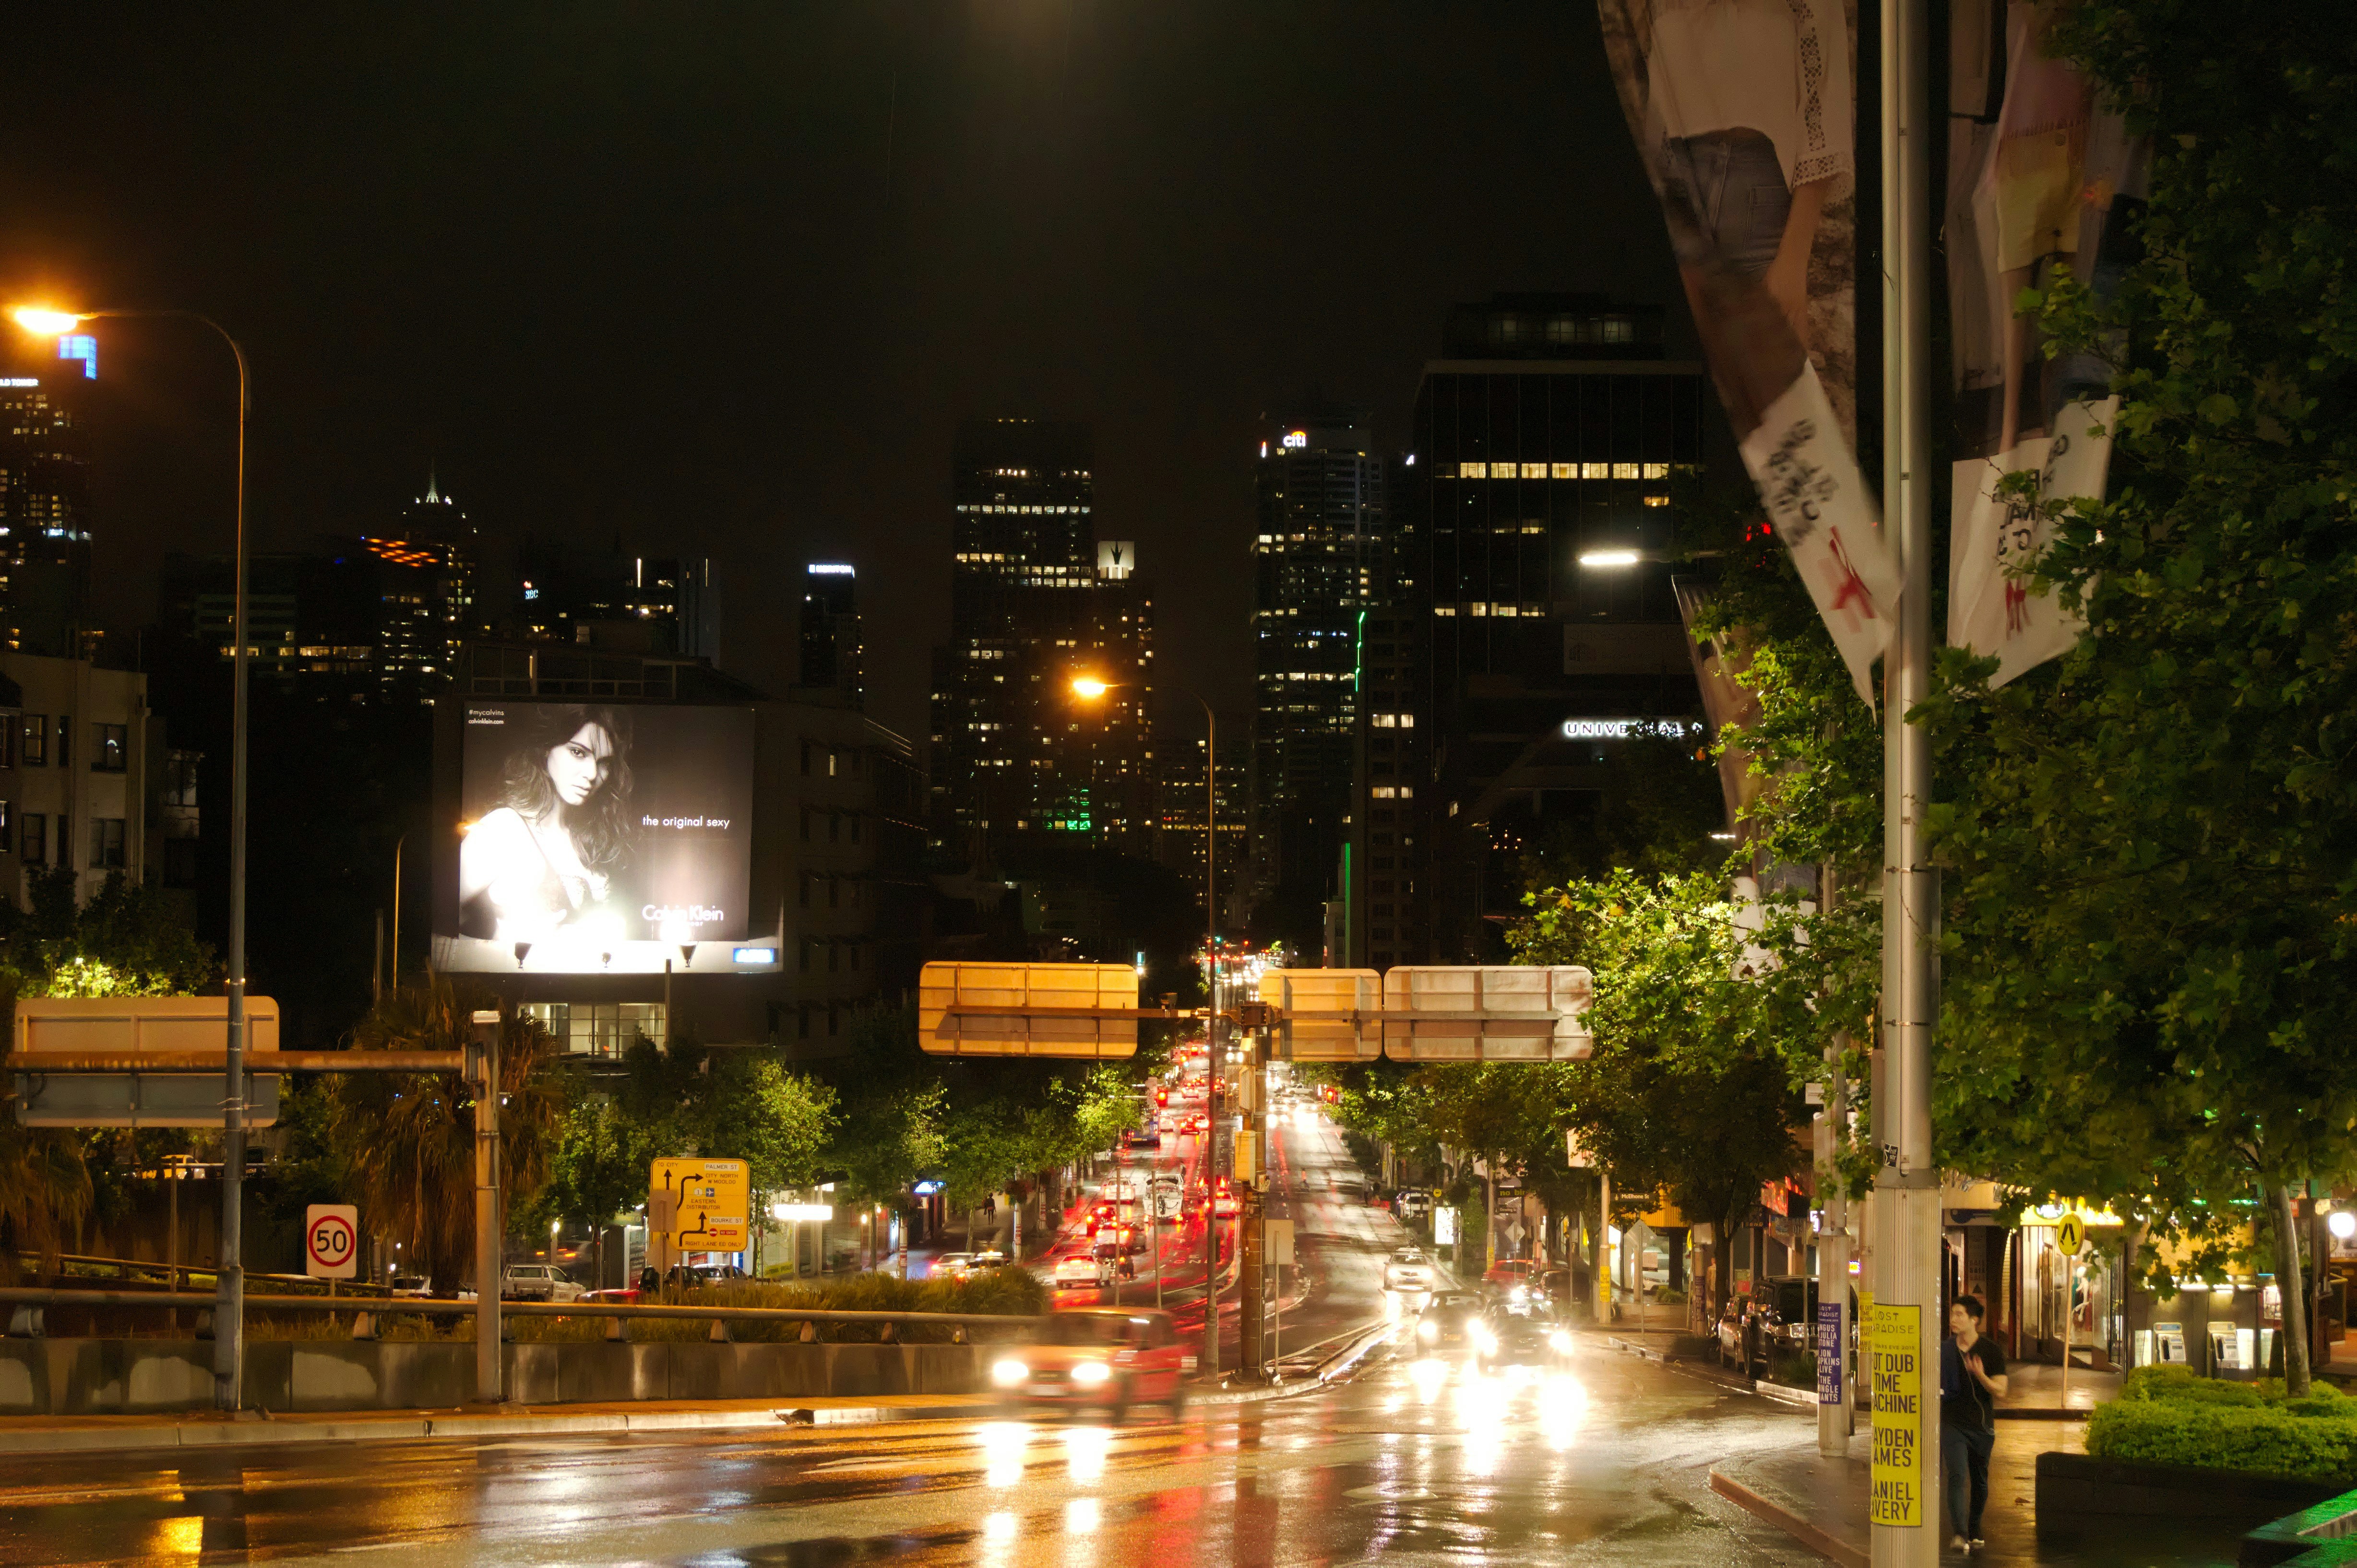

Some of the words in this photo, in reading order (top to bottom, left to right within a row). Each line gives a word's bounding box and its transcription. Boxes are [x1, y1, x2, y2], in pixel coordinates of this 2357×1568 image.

[1283, 433, 1306, 447] citi
[1567, 723, 1684, 735] UNIVEAL
[643, 814, 658, 826] the
[663, 815, 702, 829] original
[707, 819, 730, 829] sexy
[690, 905, 724, 921] Klein
[317, 1230, 346, 1253] 50
[1819, 1339, 1834, 1347] TONE
[1821, 1349, 1831, 1357] JON
[1819, 1365, 1832, 1373] LIVE
[1873, 1352, 1882, 1371] OT
[1886, 1354, 1913, 1372] DUB
[1820, 1376, 1831, 1385] THE
[1874, 1372, 1900, 1392] TIME
[1873, 1393, 1916, 1414] ACHINE
[1874, 1426, 1914, 1447] AYDEN
[1874, 1446, 1911, 1467] AMES
[1874, 1480, 1914, 1501] ANIEL
